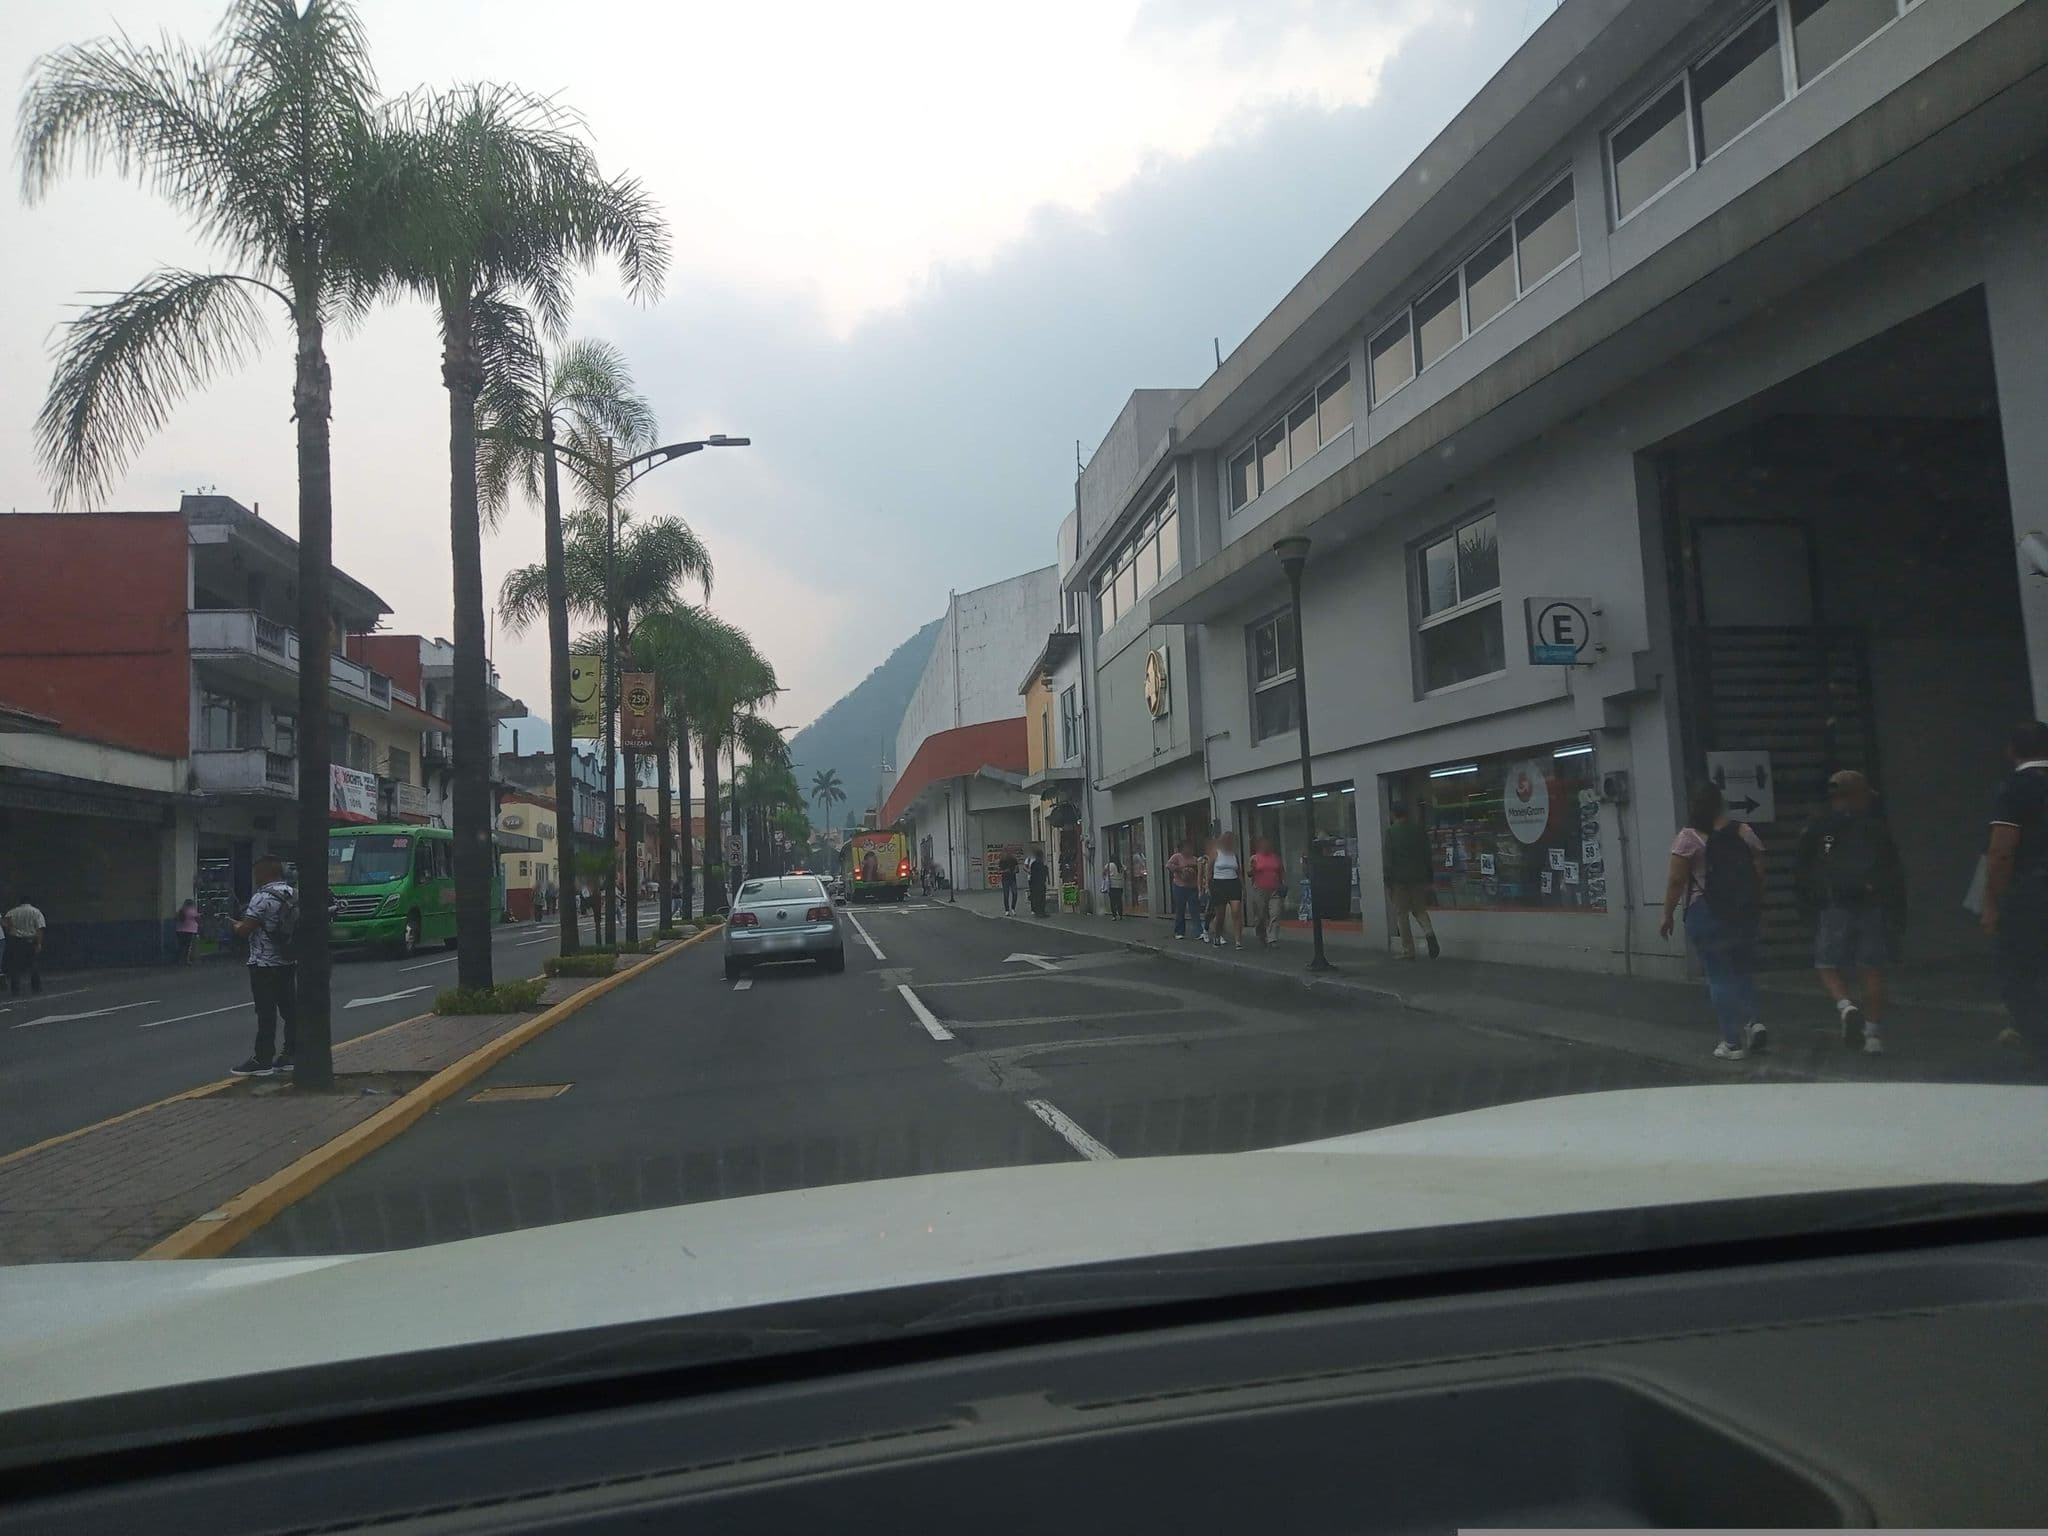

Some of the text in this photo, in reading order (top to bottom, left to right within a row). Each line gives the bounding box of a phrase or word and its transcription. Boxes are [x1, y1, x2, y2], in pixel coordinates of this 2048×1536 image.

[1552, 615, 1575, 645] E
[631, 694, 648, 705] 250
[624, 740, 653, 748] ORIZABA
[1508, 806, 1546, 818] MoneyGram
